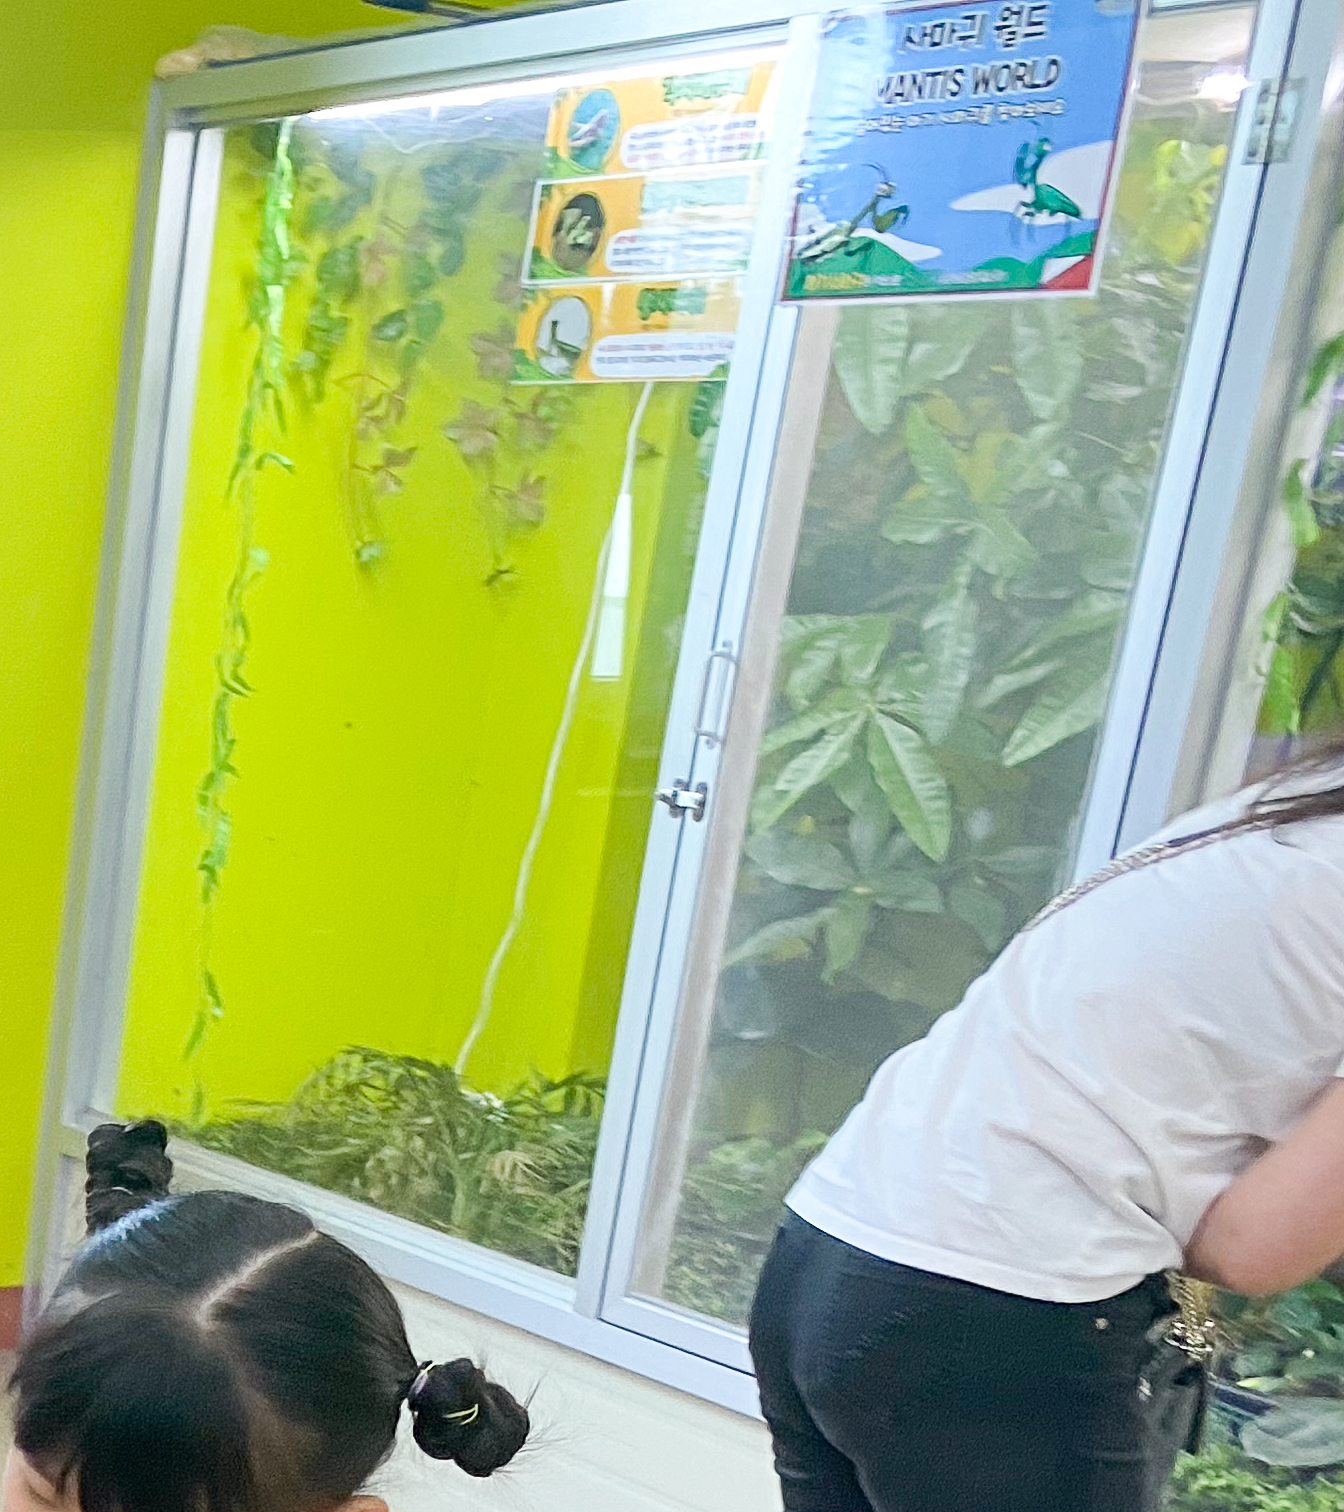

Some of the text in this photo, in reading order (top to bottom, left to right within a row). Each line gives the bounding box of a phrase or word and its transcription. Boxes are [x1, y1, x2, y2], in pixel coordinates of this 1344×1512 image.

[902, 4, 1050, 53] 사마귀 월드
[972, 57, 1062, 97] WORLD
